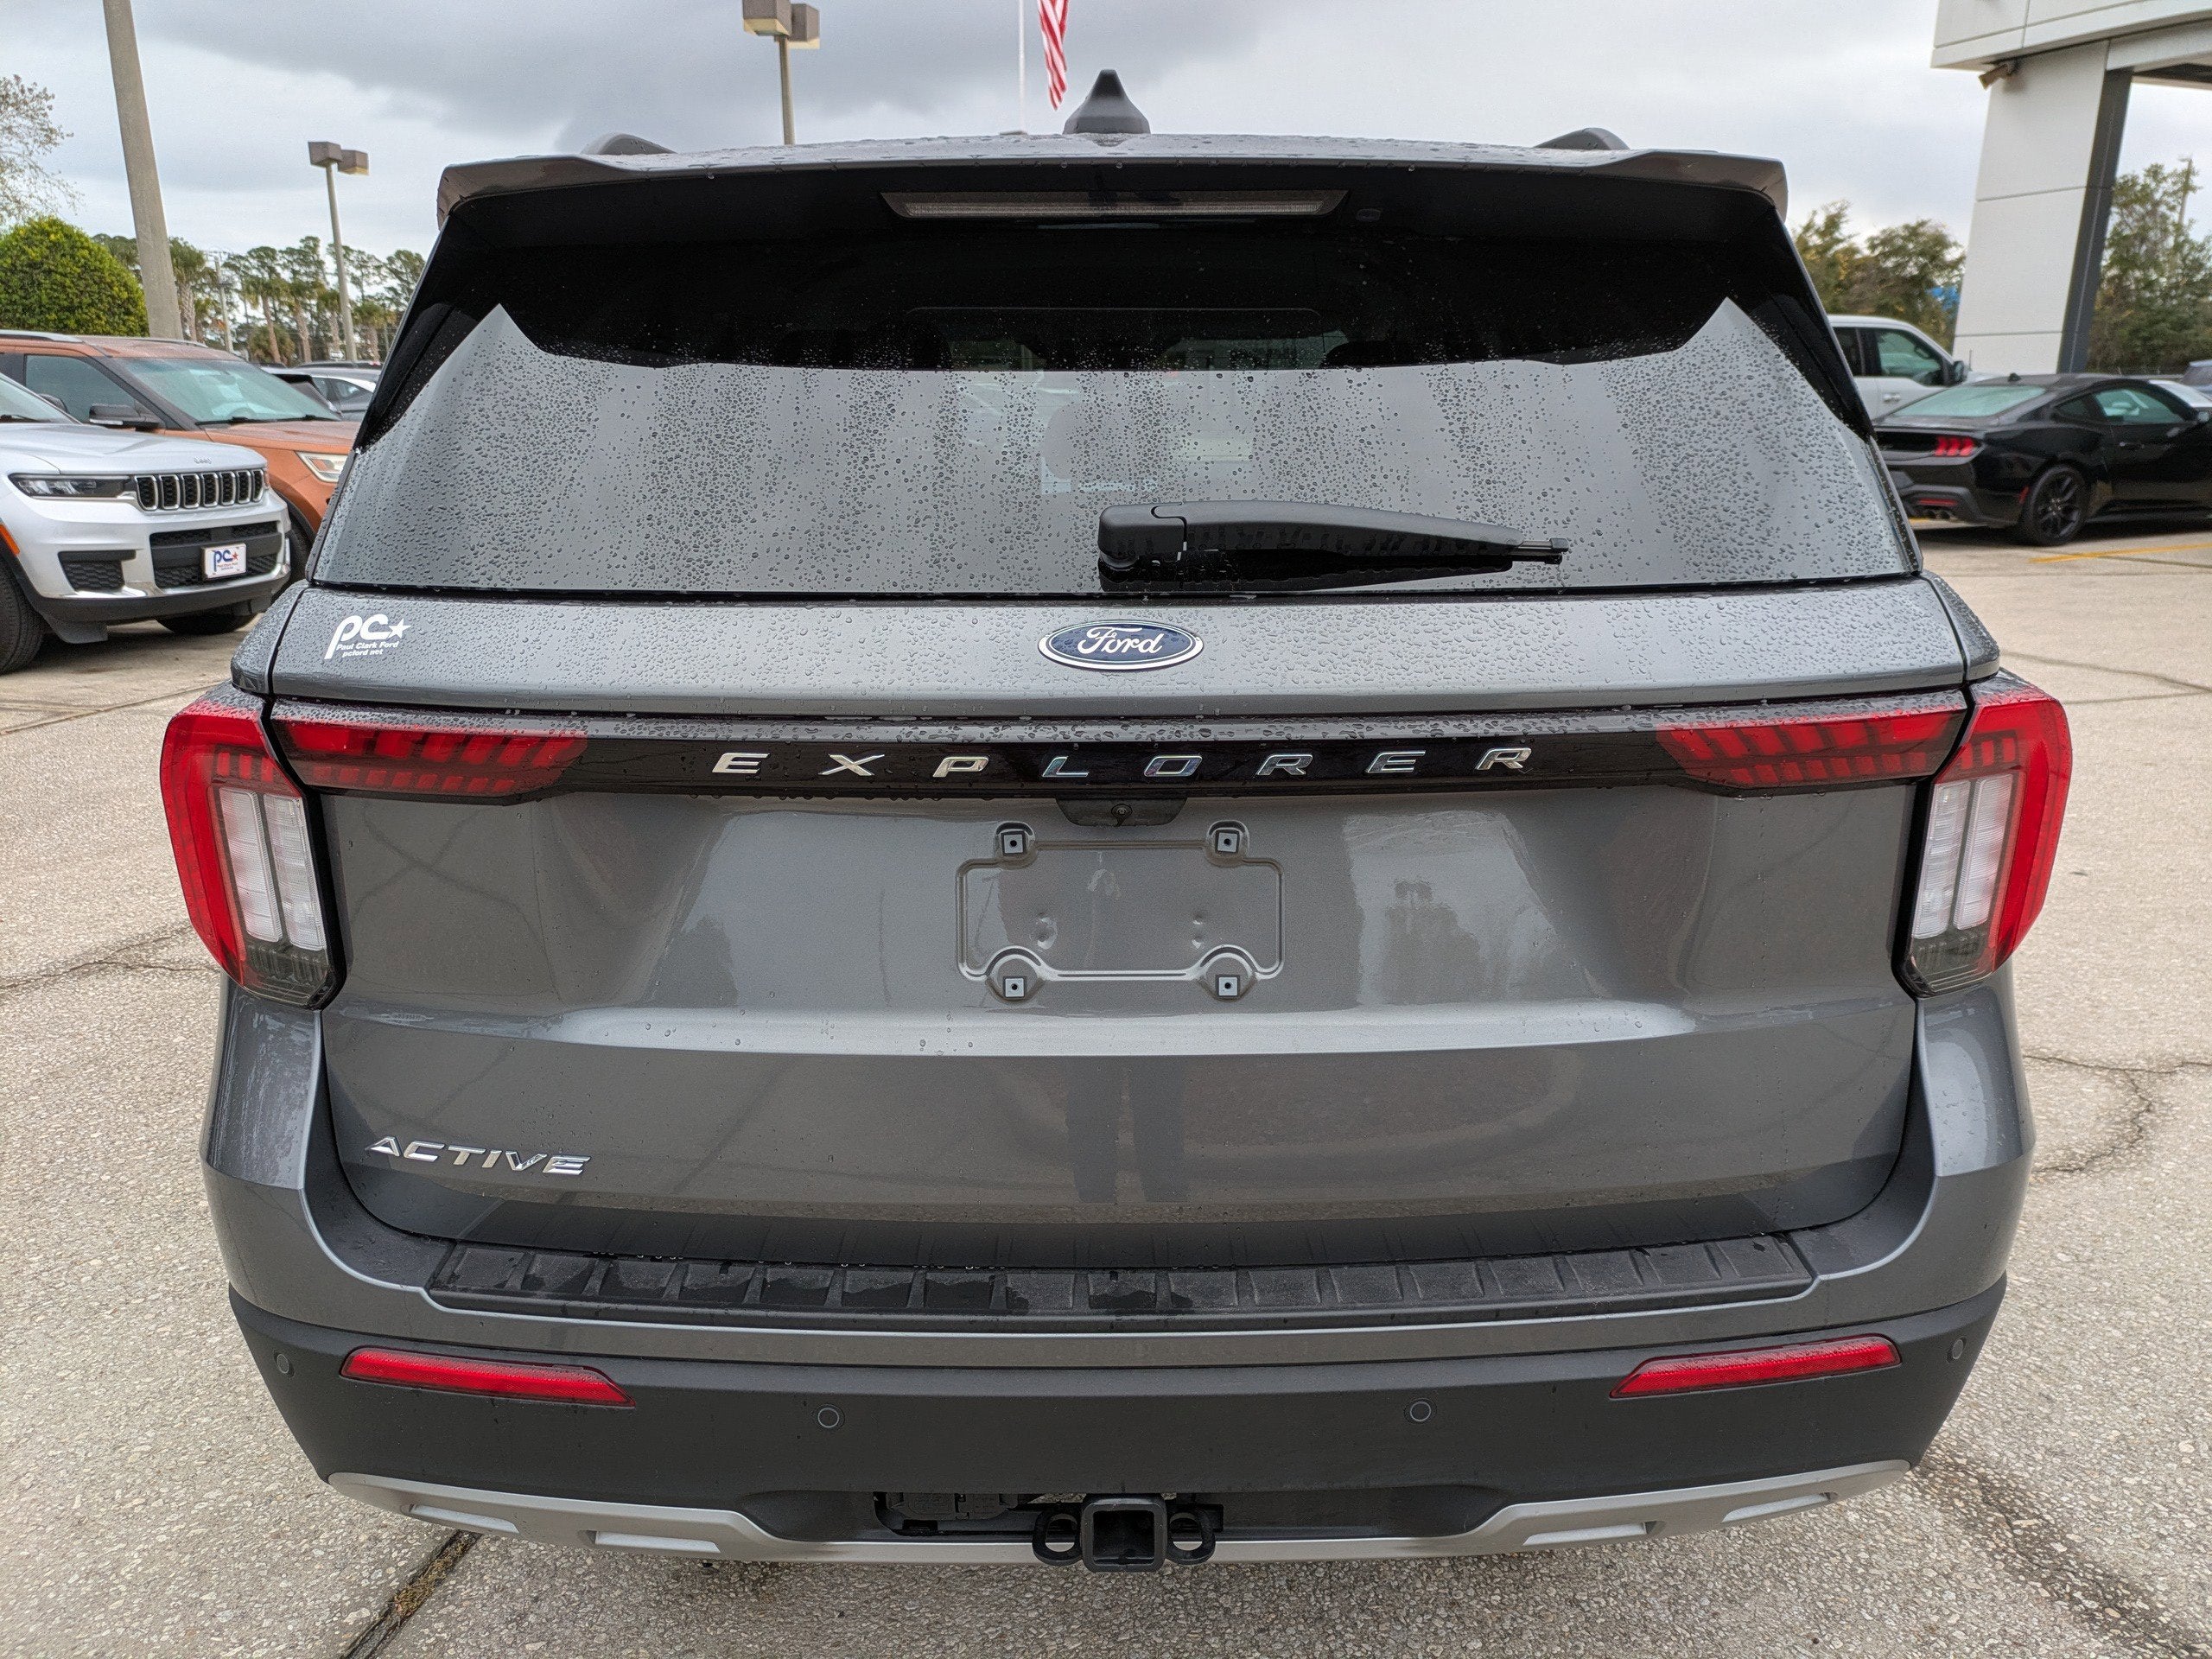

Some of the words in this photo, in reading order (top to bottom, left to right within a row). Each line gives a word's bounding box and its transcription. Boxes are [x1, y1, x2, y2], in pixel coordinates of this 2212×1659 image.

[356, 641, 377, 650] Clark
[1077, 626, 1165, 654] Ford
[712, 747, 1532, 778] EXPLORER
[365, 1136, 591, 1175] ACTIVE
